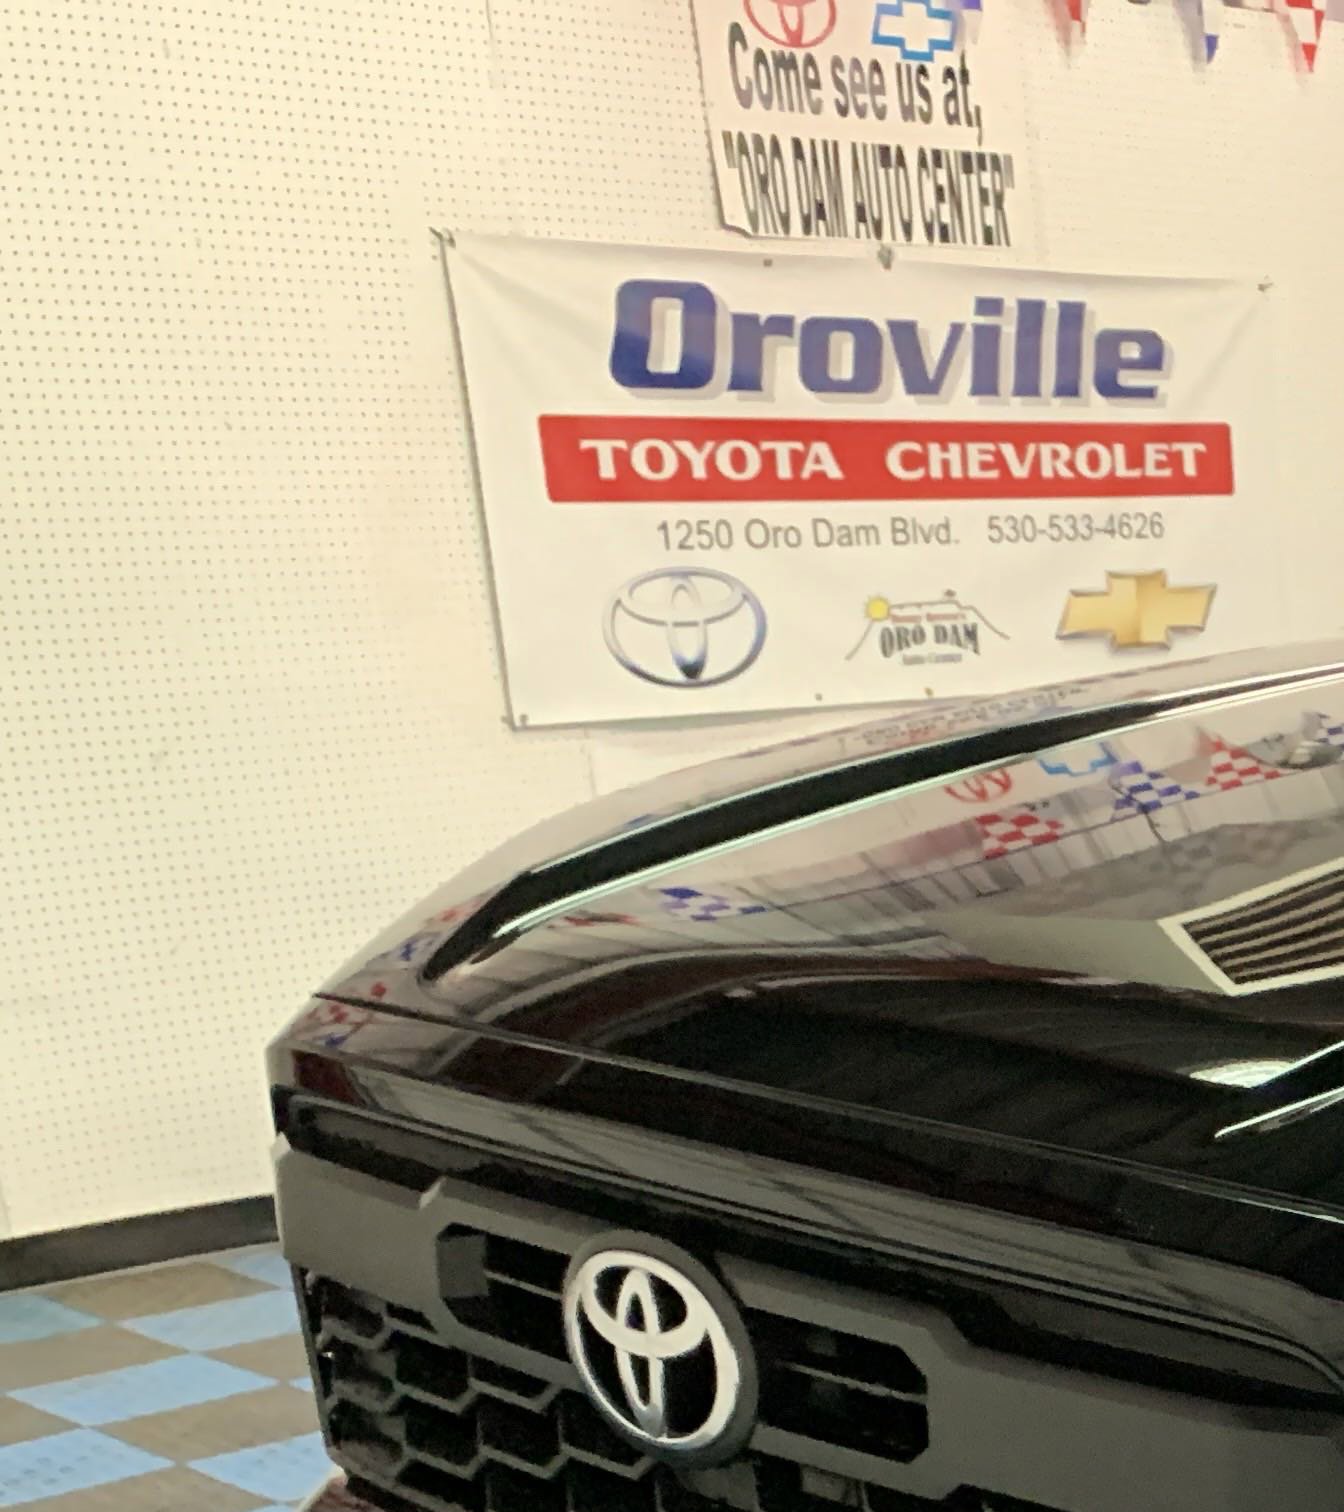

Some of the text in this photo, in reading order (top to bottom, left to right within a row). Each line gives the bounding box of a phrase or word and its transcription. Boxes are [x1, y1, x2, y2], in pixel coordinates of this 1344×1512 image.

[728, 21, 824, 115] Come
[831, 55, 887, 121] see
[896, 62, 933, 125] us
[791, 136, 848, 238] DAM
[851, 141, 912, 242] AUTO
[608, 278, 1167, 402] Oroville
[579, 437, 1207, 481] TOYOTA CHEVROLET
[656, 511, 1166, 551] 1250 Oro Dam Blvd. 530-533-4626
